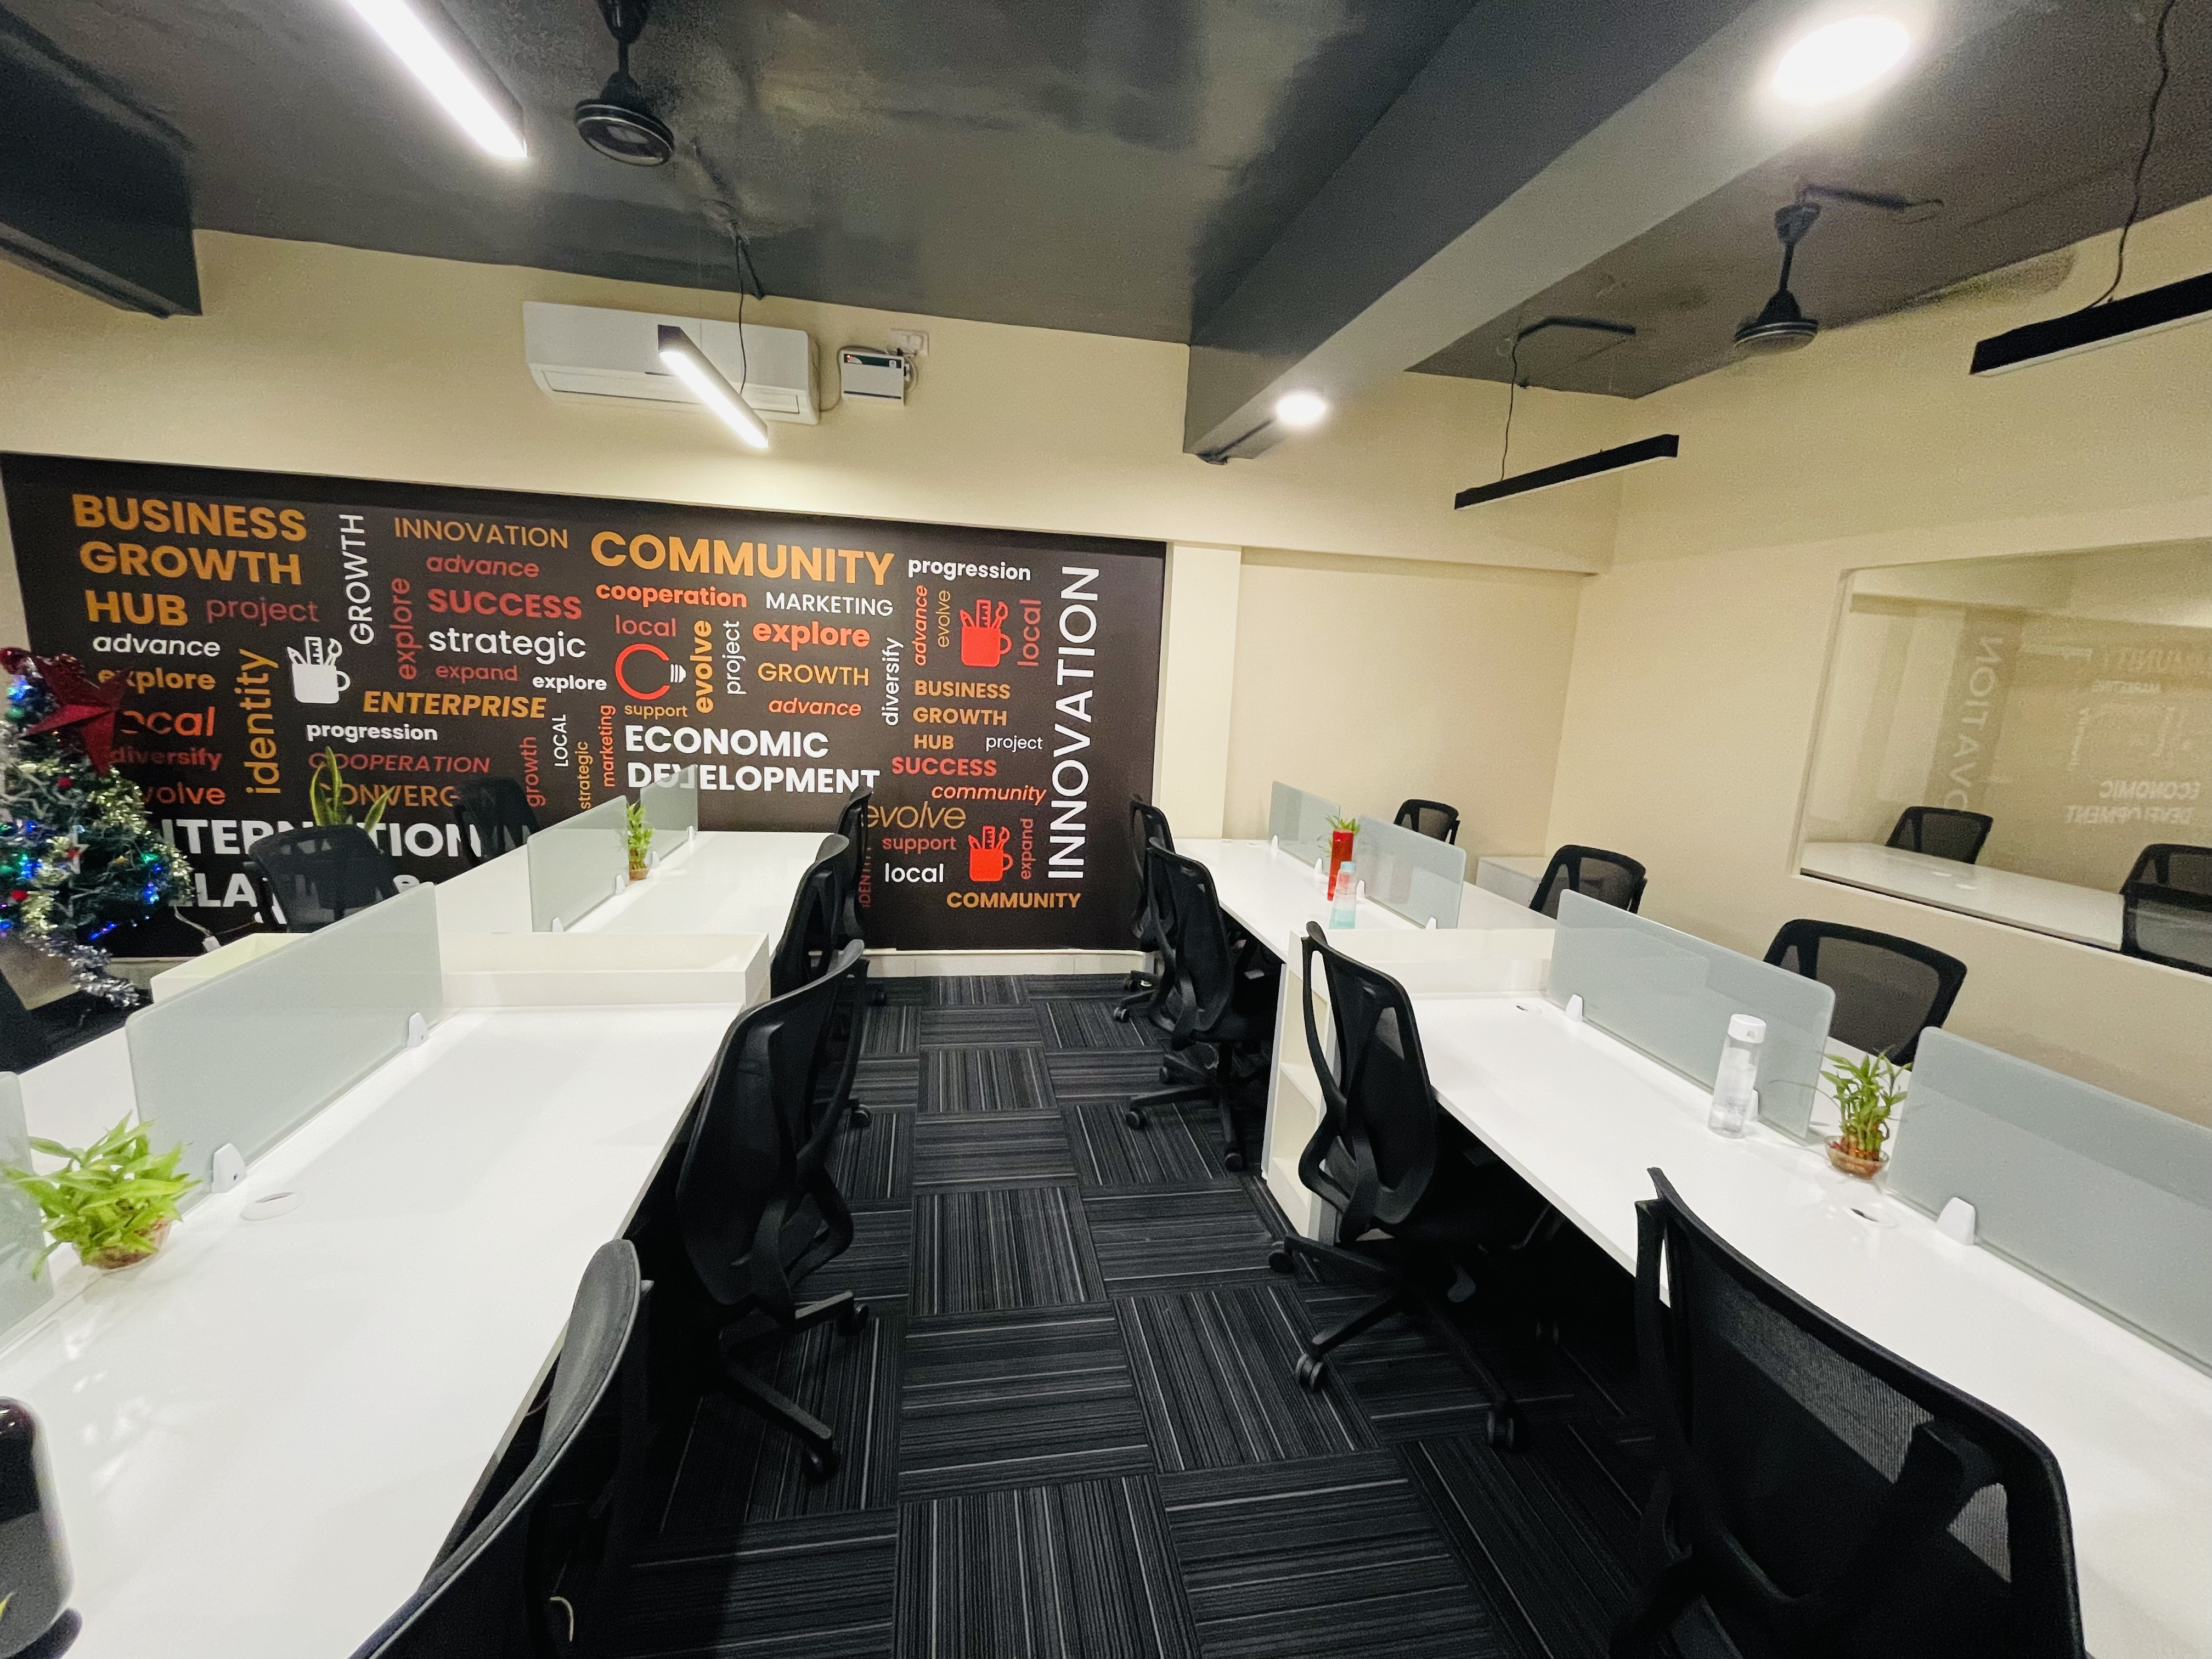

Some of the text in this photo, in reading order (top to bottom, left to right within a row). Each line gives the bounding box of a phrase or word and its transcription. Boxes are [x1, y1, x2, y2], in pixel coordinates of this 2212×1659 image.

[72, 494, 307, 541] BUSINESS
[394, 517, 568, 549] INNOVATION
[80, 541, 302, 585] GROWTH
[426, 555, 539, 578] advance
[591, 531, 895, 585] COMMUNITY
[908, 558, 1031, 581] progression
[338, 514, 374, 645] GROWTH
[86, 589, 188, 626] HUB
[426, 588, 583, 620] SUCCESS
[596, 583, 747, 608] cooperation
[765, 591, 894, 616] MARKETING
[206, 596, 319, 626] project
[615, 614, 676, 636] local
[911, 585, 928, 667] advance
[935, 590, 951, 647] evolve
[389, 577, 424, 680] explore
[752, 620, 871, 651] explore
[1017, 599, 1041, 666] local
[92, 633, 221, 657] advance
[428, 627, 587, 664] strategic
[722, 620, 747, 695] project
[435, 664, 518, 684] expand
[690, 620, 713, 713] evolve
[757, 662, 869, 686] GROWTH
[881, 637, 904, 726] diversify
[532, 674, 607, 693] explore
[915, 680, 1011, 700] BUSINESS
[363, 690, 547, 719] ENTERPRISE
[624, 704, 688, 720] support
[768, 697, 862, 716] advance
[912, 707, 1007, 726] GROWTH
[234, 648, 281, 794] identity
[306, 723, 438, 743] progression
[1048, 566, 1100, 879] INNOVATION
[551, 714, 569, 768] LOCAL
[597, 704, 616, 788] marketing
[625, 724, 829, 758] ECONOMIC
[913, 734, 955, 751] HUB
[985, 735, 1043, 753] project
[308, 753, 490, 773] COOPERATION
[519, 736, 547, 808] growth
[575, 741, 594, 810] strategic
[891, 757, 997, 777] SUCCESS
[932, 785, 1047, 805] community
[867, 800, 966, 830] evolve
[882, 837, 957, 854] support
[1020, 819, 1036, 880] expand
[885, 862, 944, 883] local
[946, 891, 1081, 909] COMMUNITY
